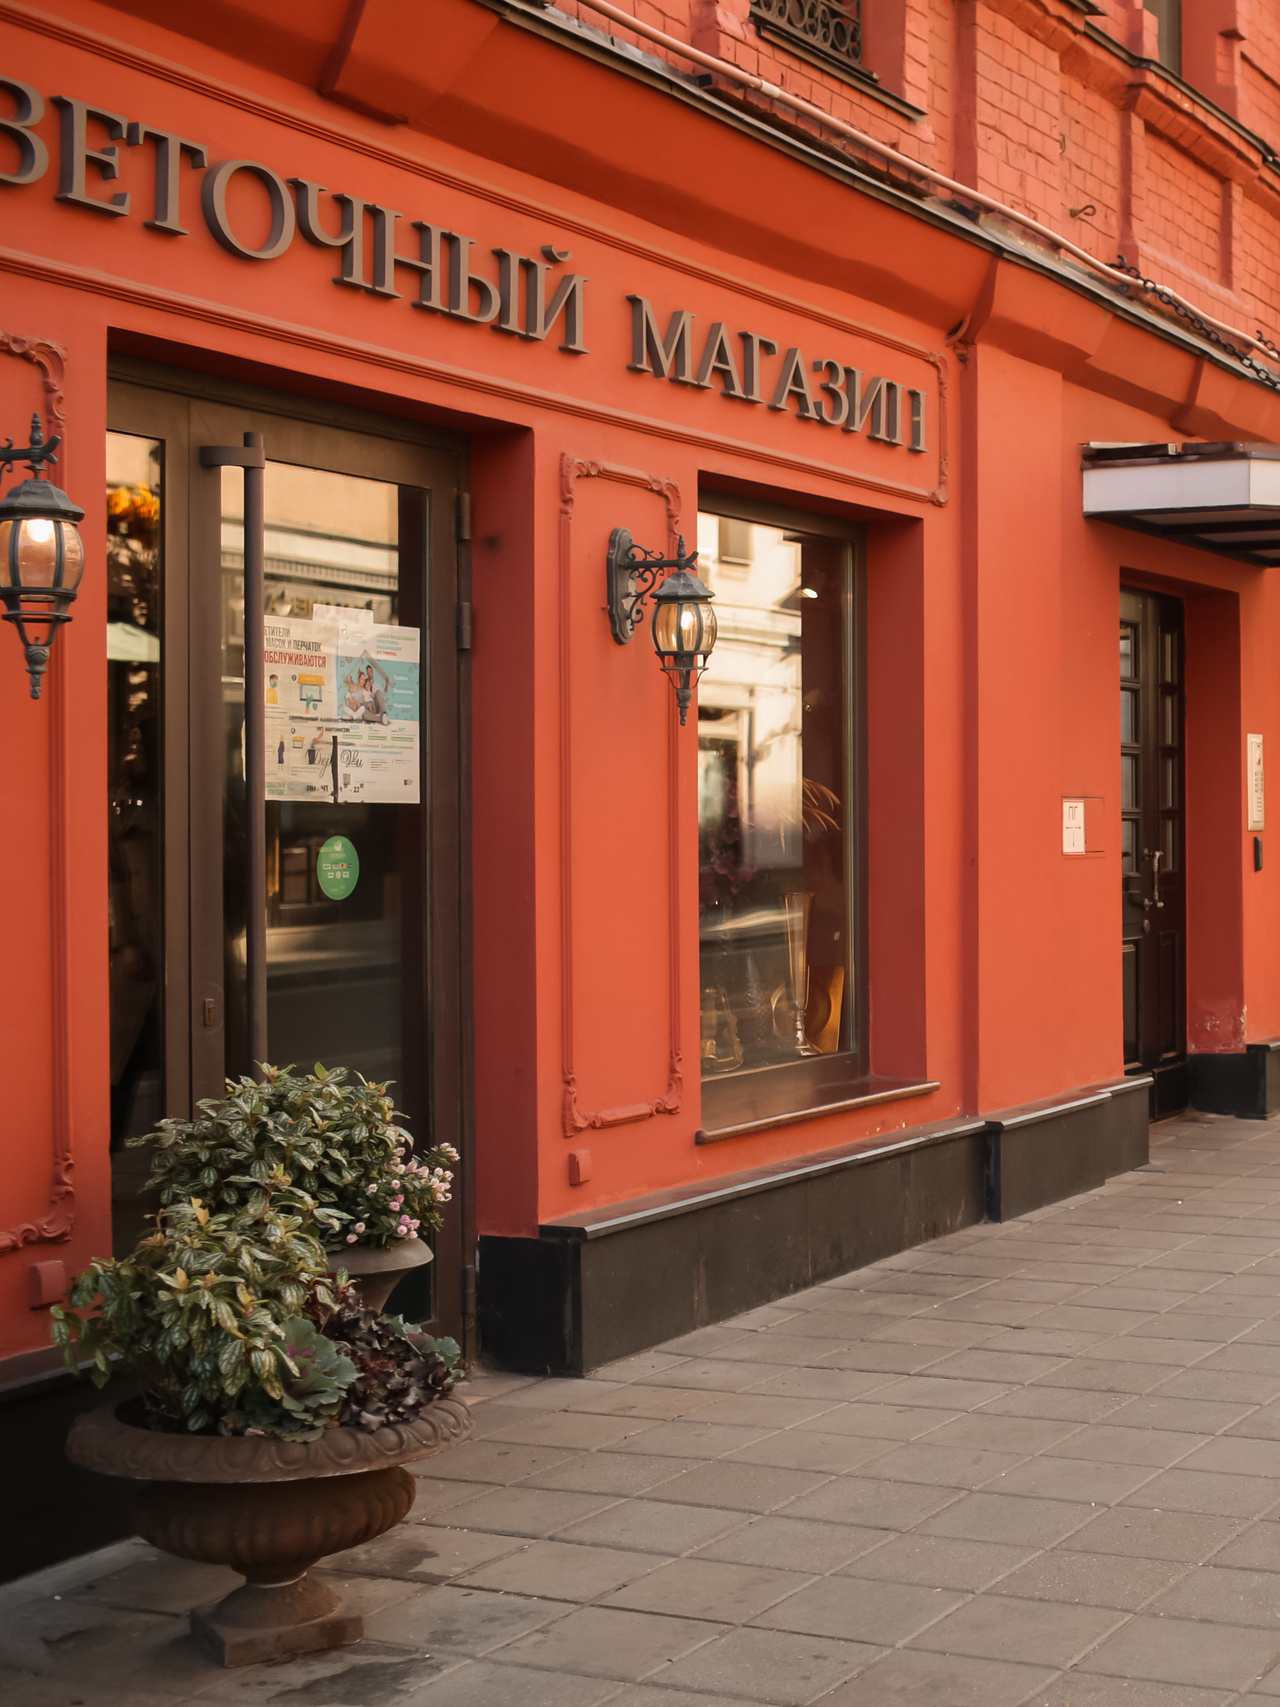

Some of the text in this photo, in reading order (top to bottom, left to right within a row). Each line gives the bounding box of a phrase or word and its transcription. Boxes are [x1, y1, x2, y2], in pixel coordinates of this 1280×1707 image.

[625, 294, 930, 453] МАГАЗИН
[293, 640, 322, 652] ПЕРЧАТОК
[264, 651, 327, 668] ОБСЛУЖИВАЮТСЯ
